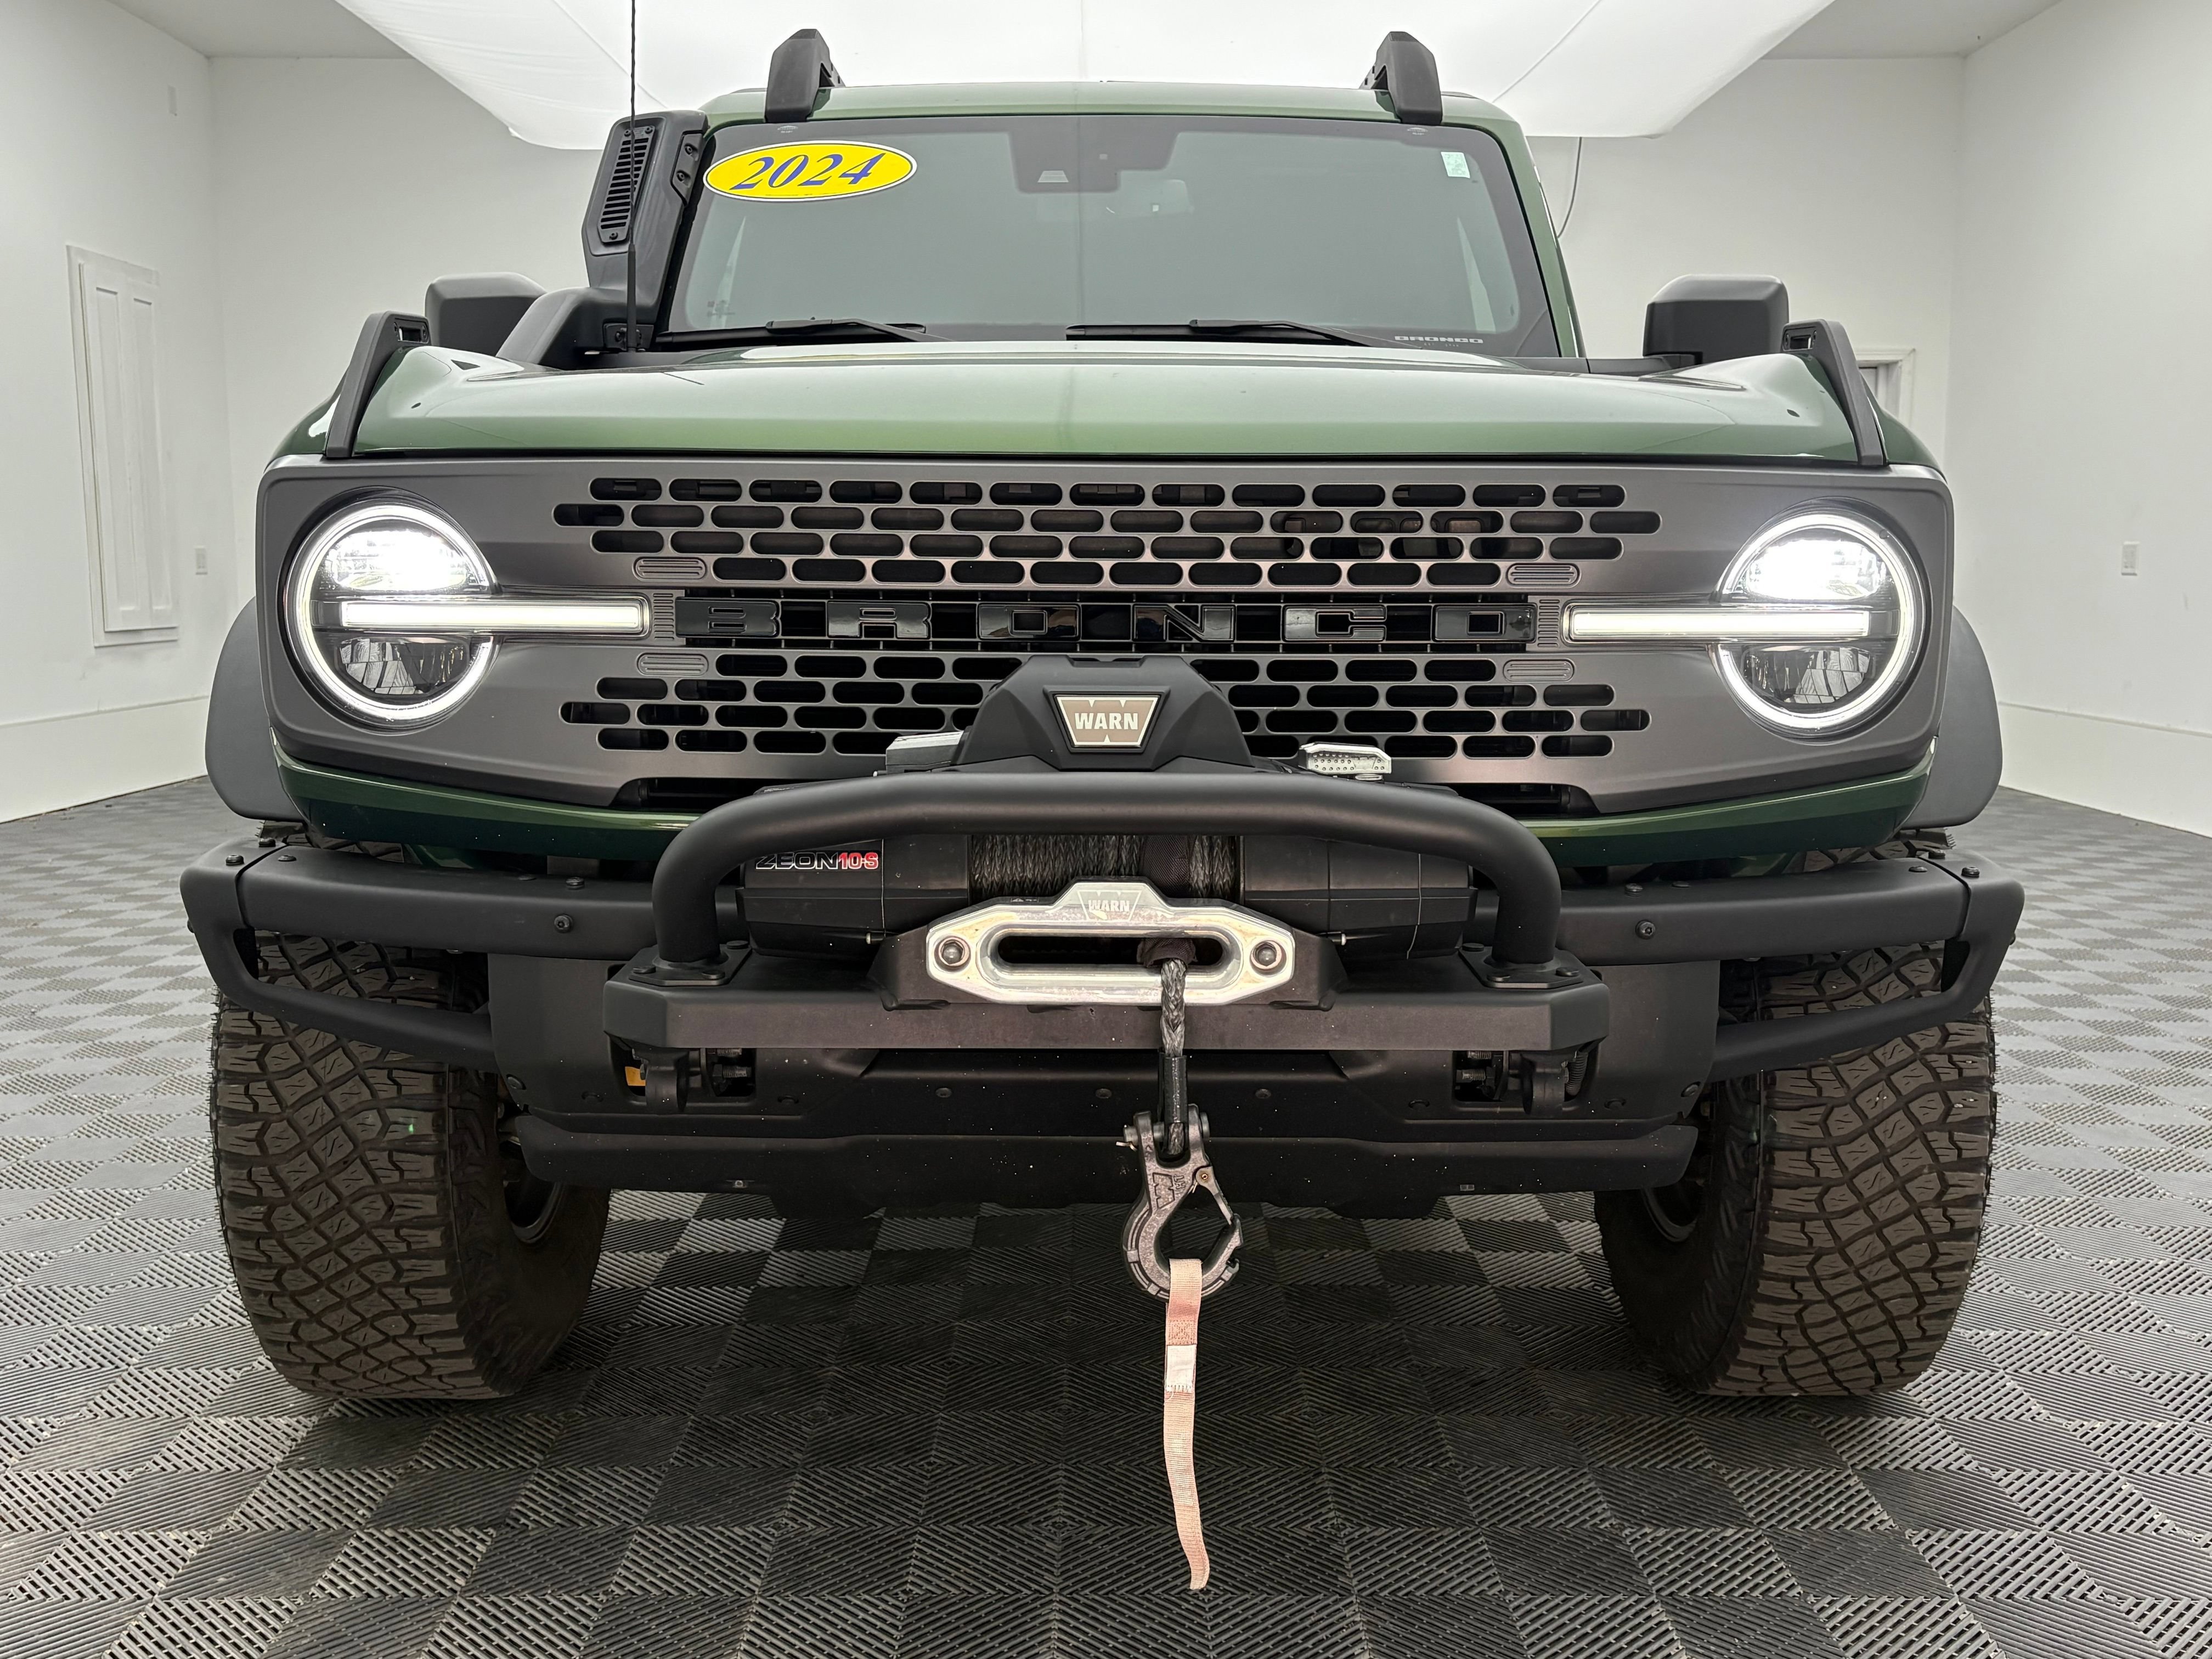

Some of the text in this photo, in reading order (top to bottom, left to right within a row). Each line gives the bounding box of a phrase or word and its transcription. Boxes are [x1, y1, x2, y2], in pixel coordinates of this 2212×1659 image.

[729, 153, 886, 190] 2024
[675, 596, 1538, 643] BRONCO
[1074, 713, 1138, 730] WARN
[1088, 899, 1130, 912] WARN
